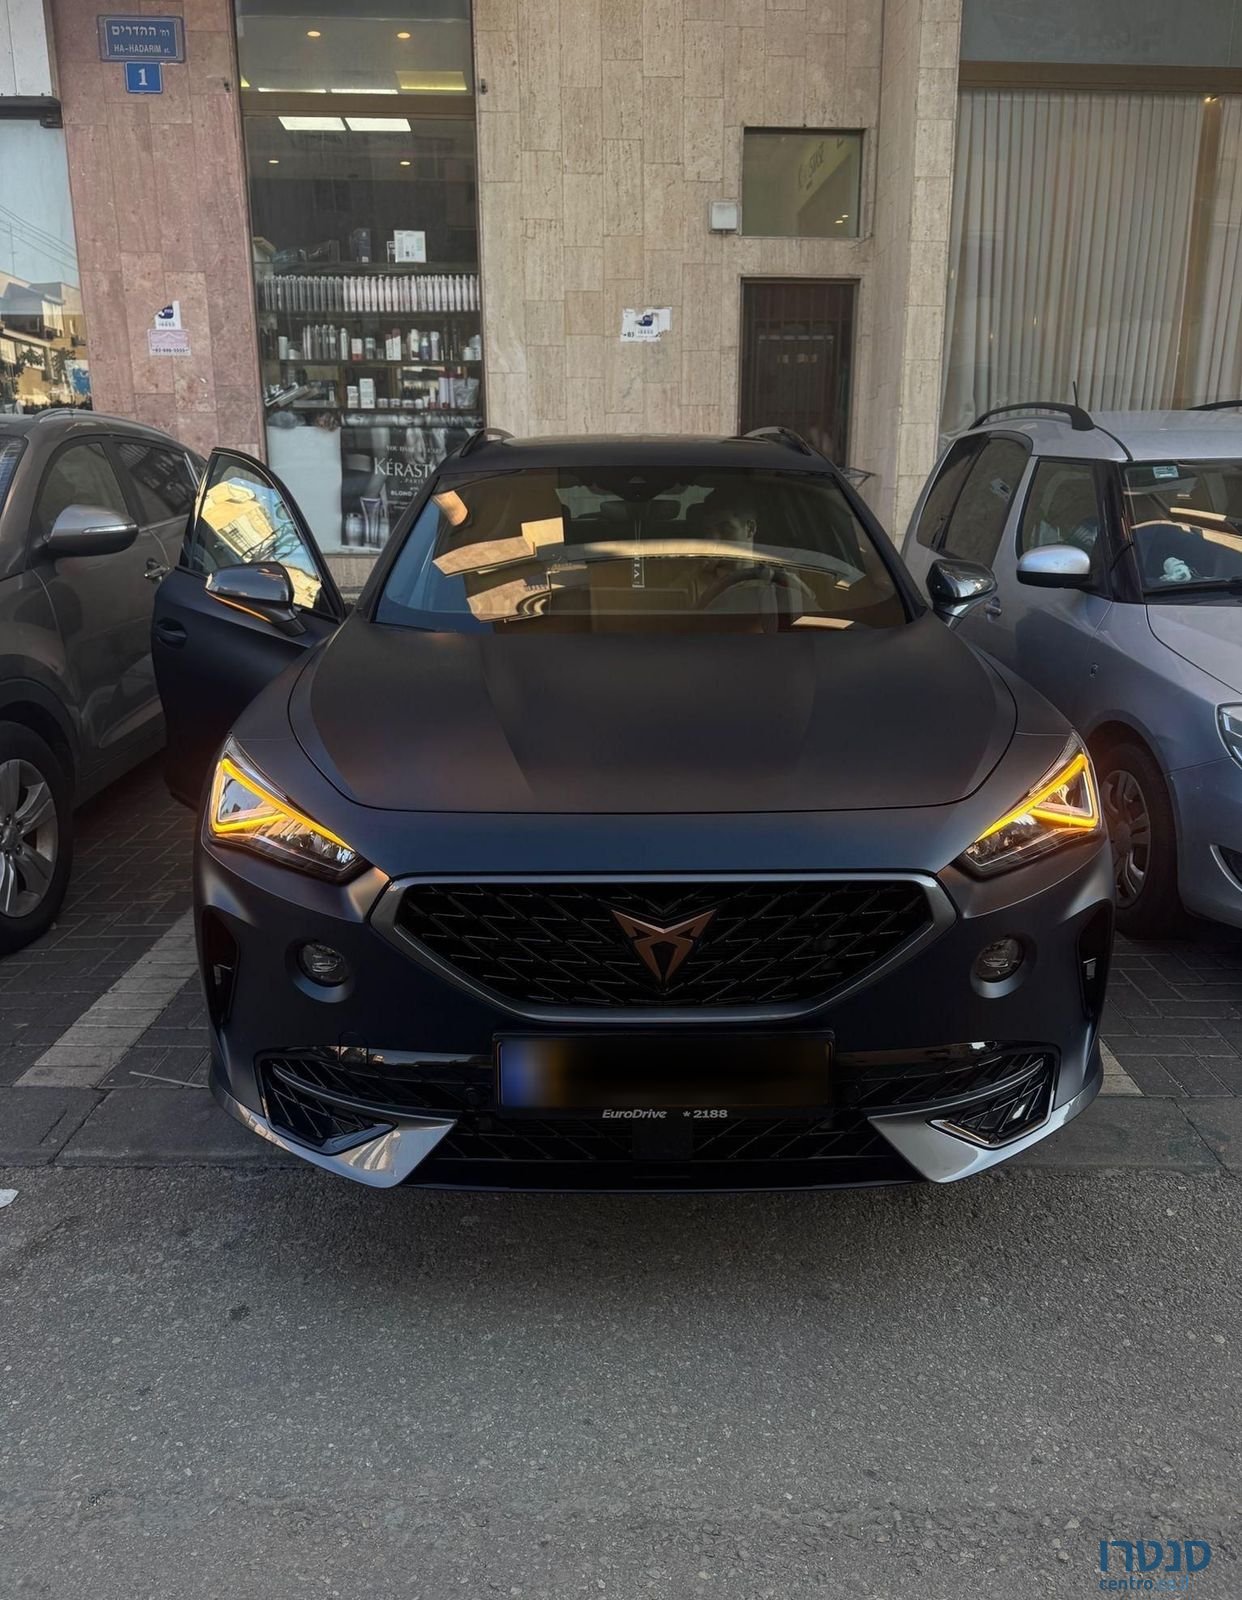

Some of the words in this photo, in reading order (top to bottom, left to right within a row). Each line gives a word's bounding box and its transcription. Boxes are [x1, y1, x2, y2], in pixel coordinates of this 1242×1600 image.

[111, 25, 157, 36] ההדרים
[114, 44, 162, 53] HA-HADARIM
[138, 68, 148, 86] 1
[374, 457, 433, 479] KÉRAST
[390, 489, 413, 497] BLOND
[602, 1109, 668, 1119] EuroDrive
